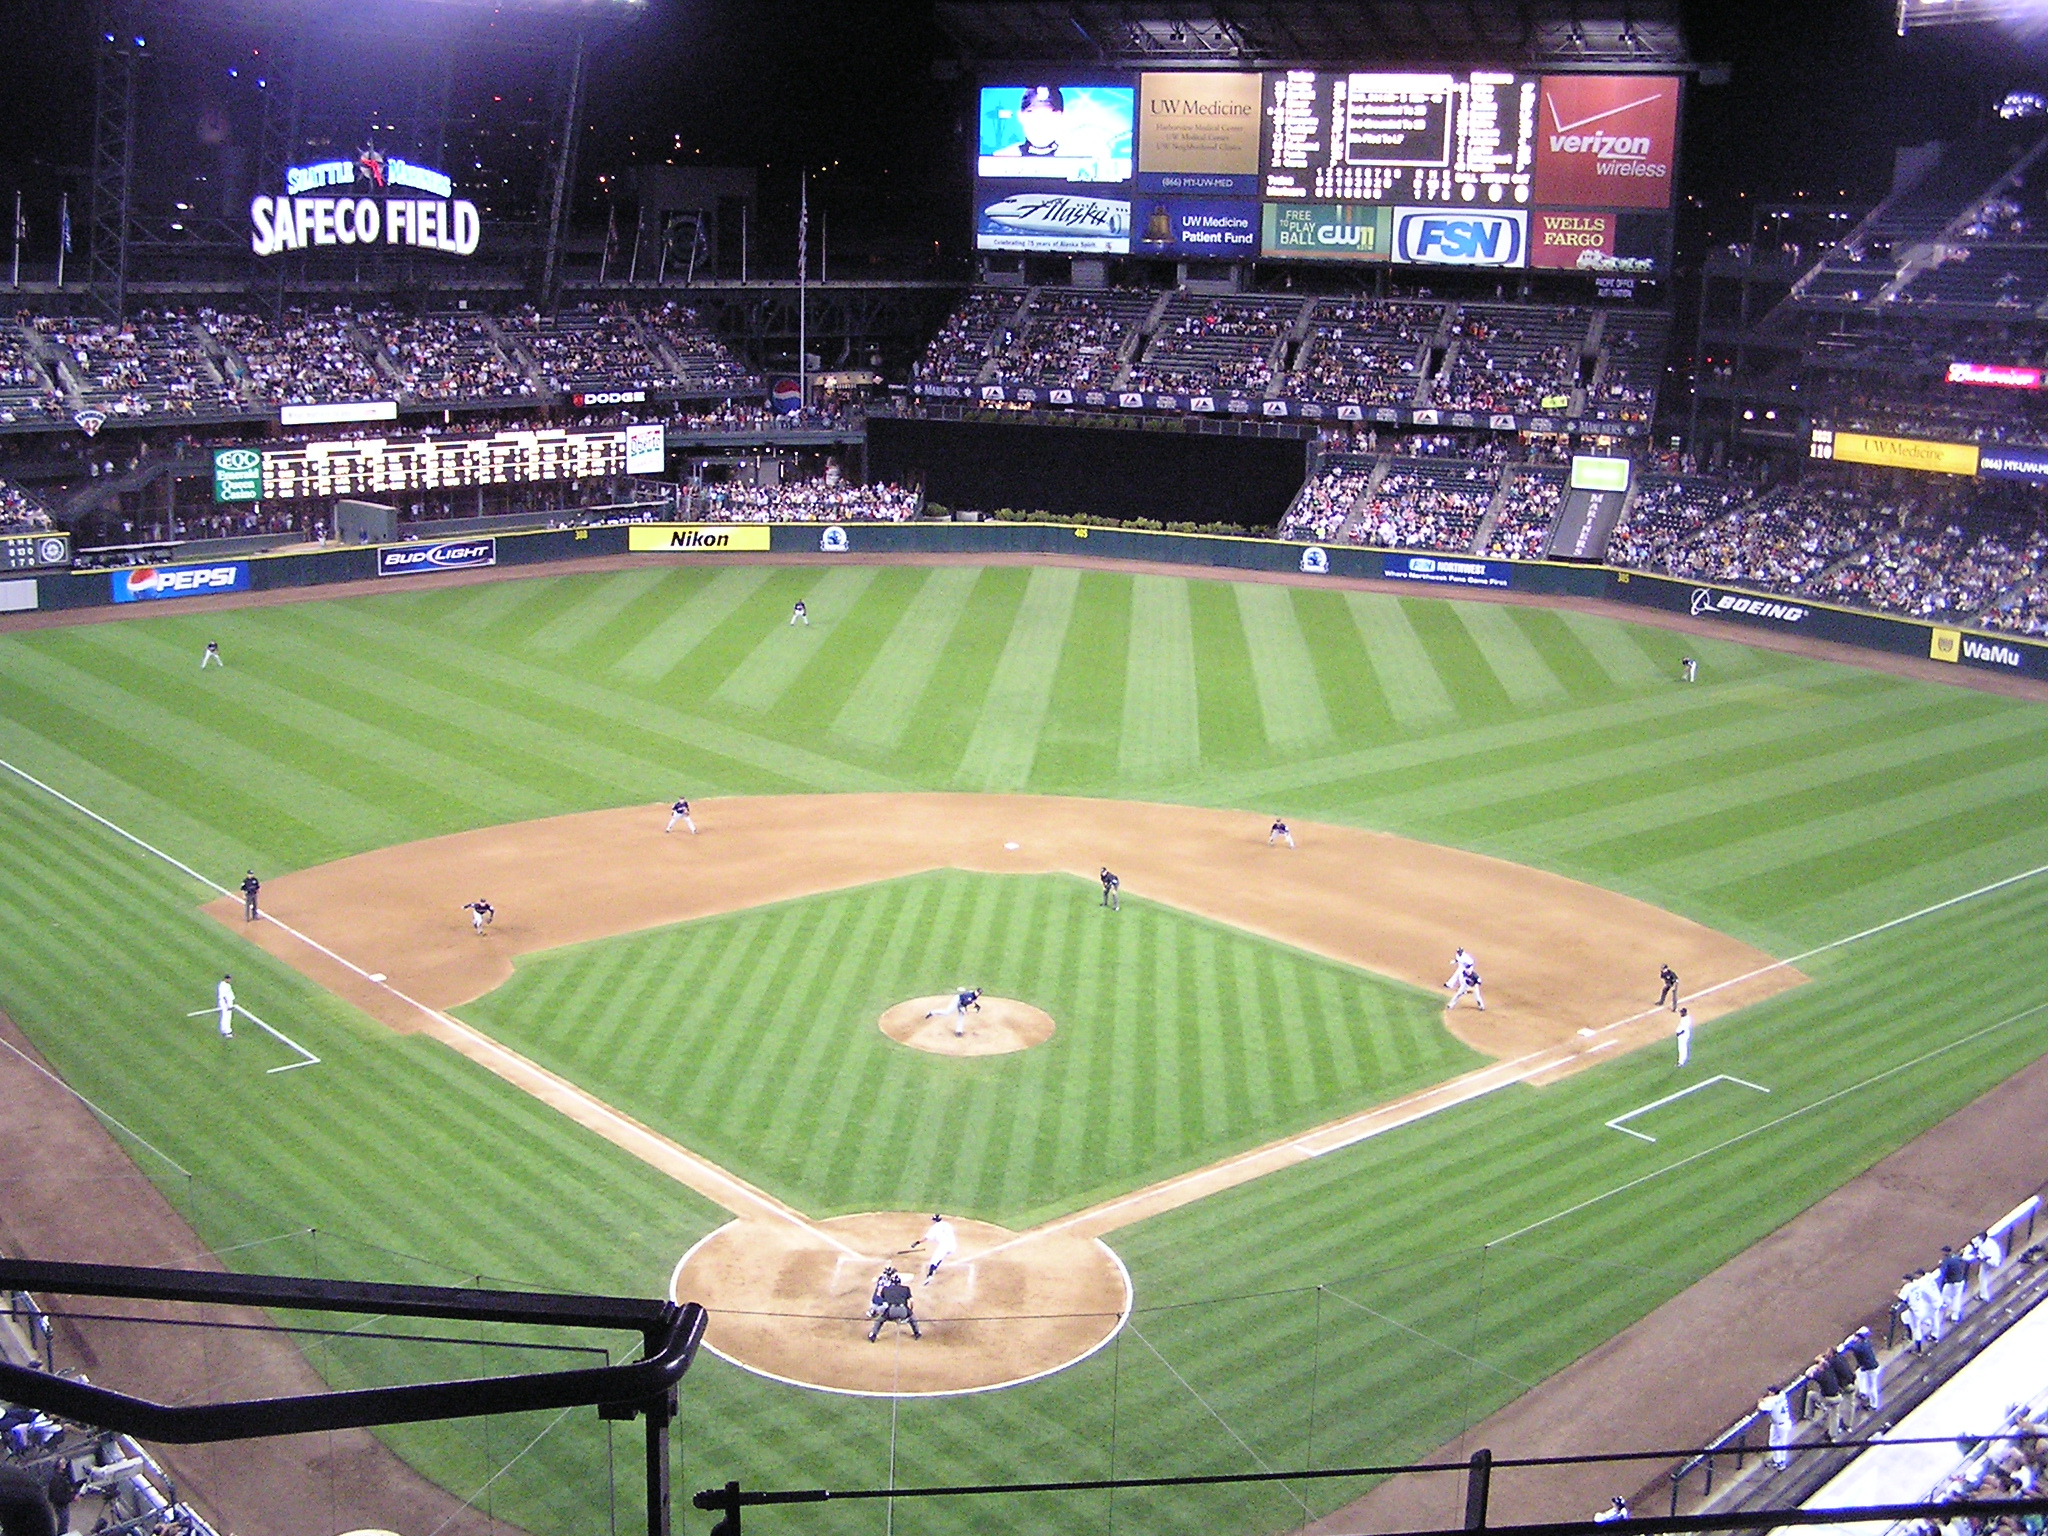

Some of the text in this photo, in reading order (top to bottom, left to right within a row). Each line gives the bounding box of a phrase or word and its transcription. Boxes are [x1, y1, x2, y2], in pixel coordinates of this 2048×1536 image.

[1151, 99, 1252, 116] UW Medicine
[1549, 131, 1650, 160] verizon
[1596, 160, 1667, 178] wireless
[288, 161, 355, 196] SEATTLE
[1017, 198, 1109, 227] Alaska
[1286, 210, 1312, 221] FREE
[251, 195, 481, 257] SAFECO FIELD
[1182, 215, 1249, 228] UW Medicine
[1280, 219, 1316, 232] TO PLAY
[1543, 216, 1605, 231] WELLS
[1182, 230, 1253, 244] Patient Fund
[1280, 231, 1316, 245] BALL
[1417, 220, 1502, 258] FSN
[1543, 232, 1604, 247] FARGO
[584, 391, 646, 405] DODGE
[1864, 439, 1945, 461] UW Medicine
[670, 531, 730, 547] Nikon
[384, 546, 490, 566] BUD LIGHT
[1437, 561, 1487, 575] NORTHWEST
[156, 567, 238, 592] PEPSI
[1716, 595, 1803, 621] BOEING
[1963, 640, 2020, 666] WaMu
